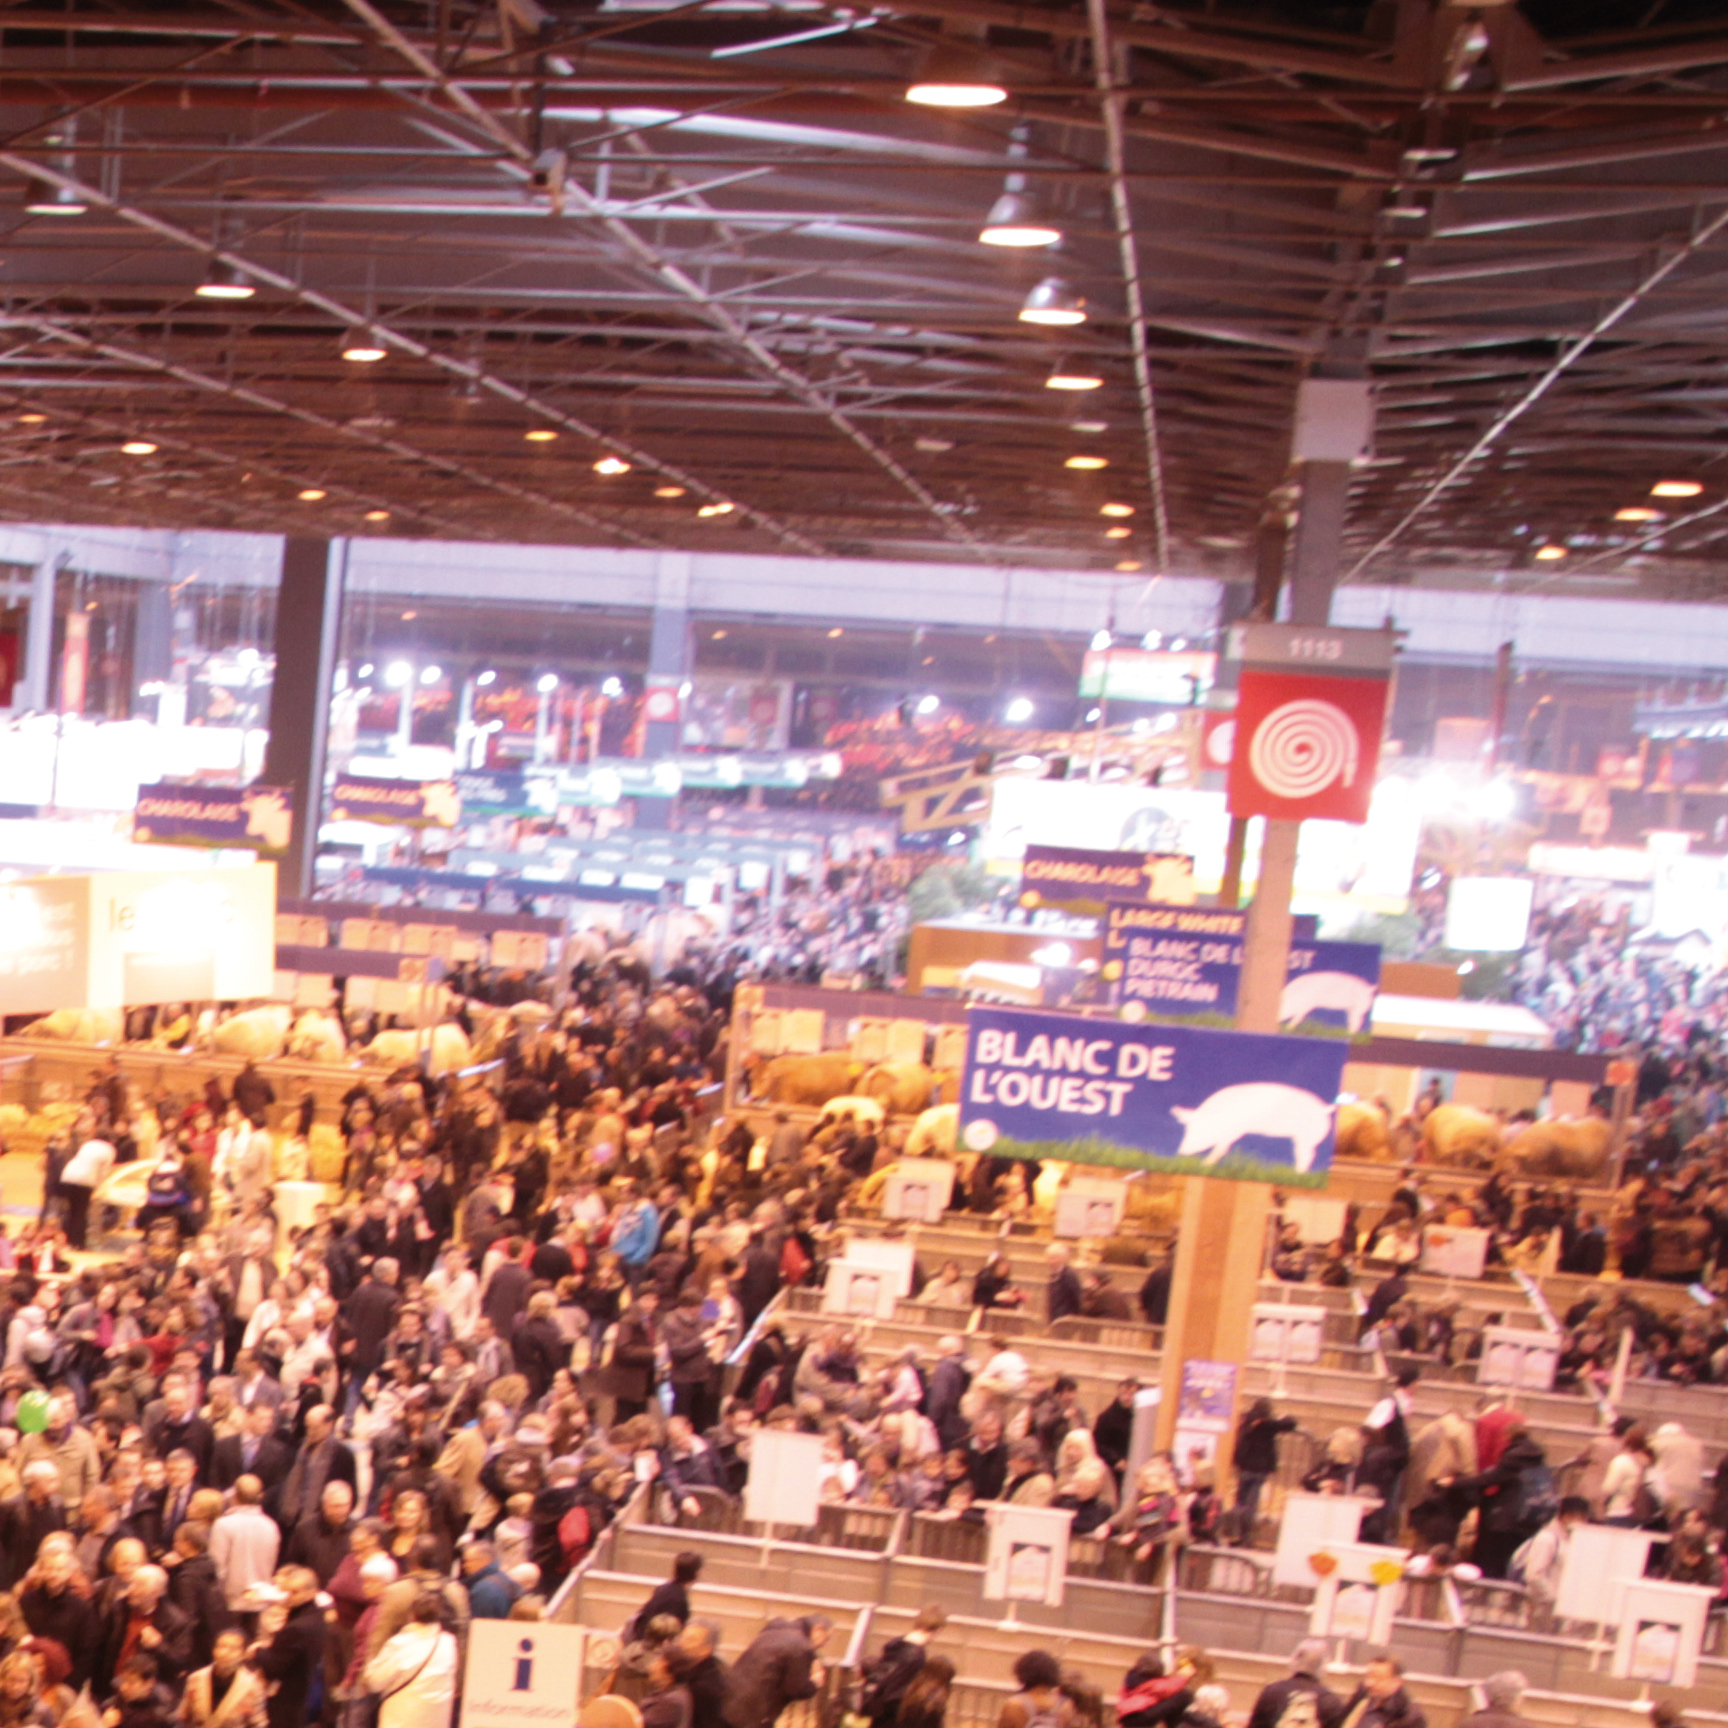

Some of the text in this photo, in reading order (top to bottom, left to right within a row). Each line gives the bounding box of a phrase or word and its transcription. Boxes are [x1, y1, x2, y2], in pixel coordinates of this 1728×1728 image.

[1128, 937, 1199, 963] BLANC
[975, 1029, 1178, 1083] BLANC DE
[970, 1067, 1135, 1119] L'OUEST
